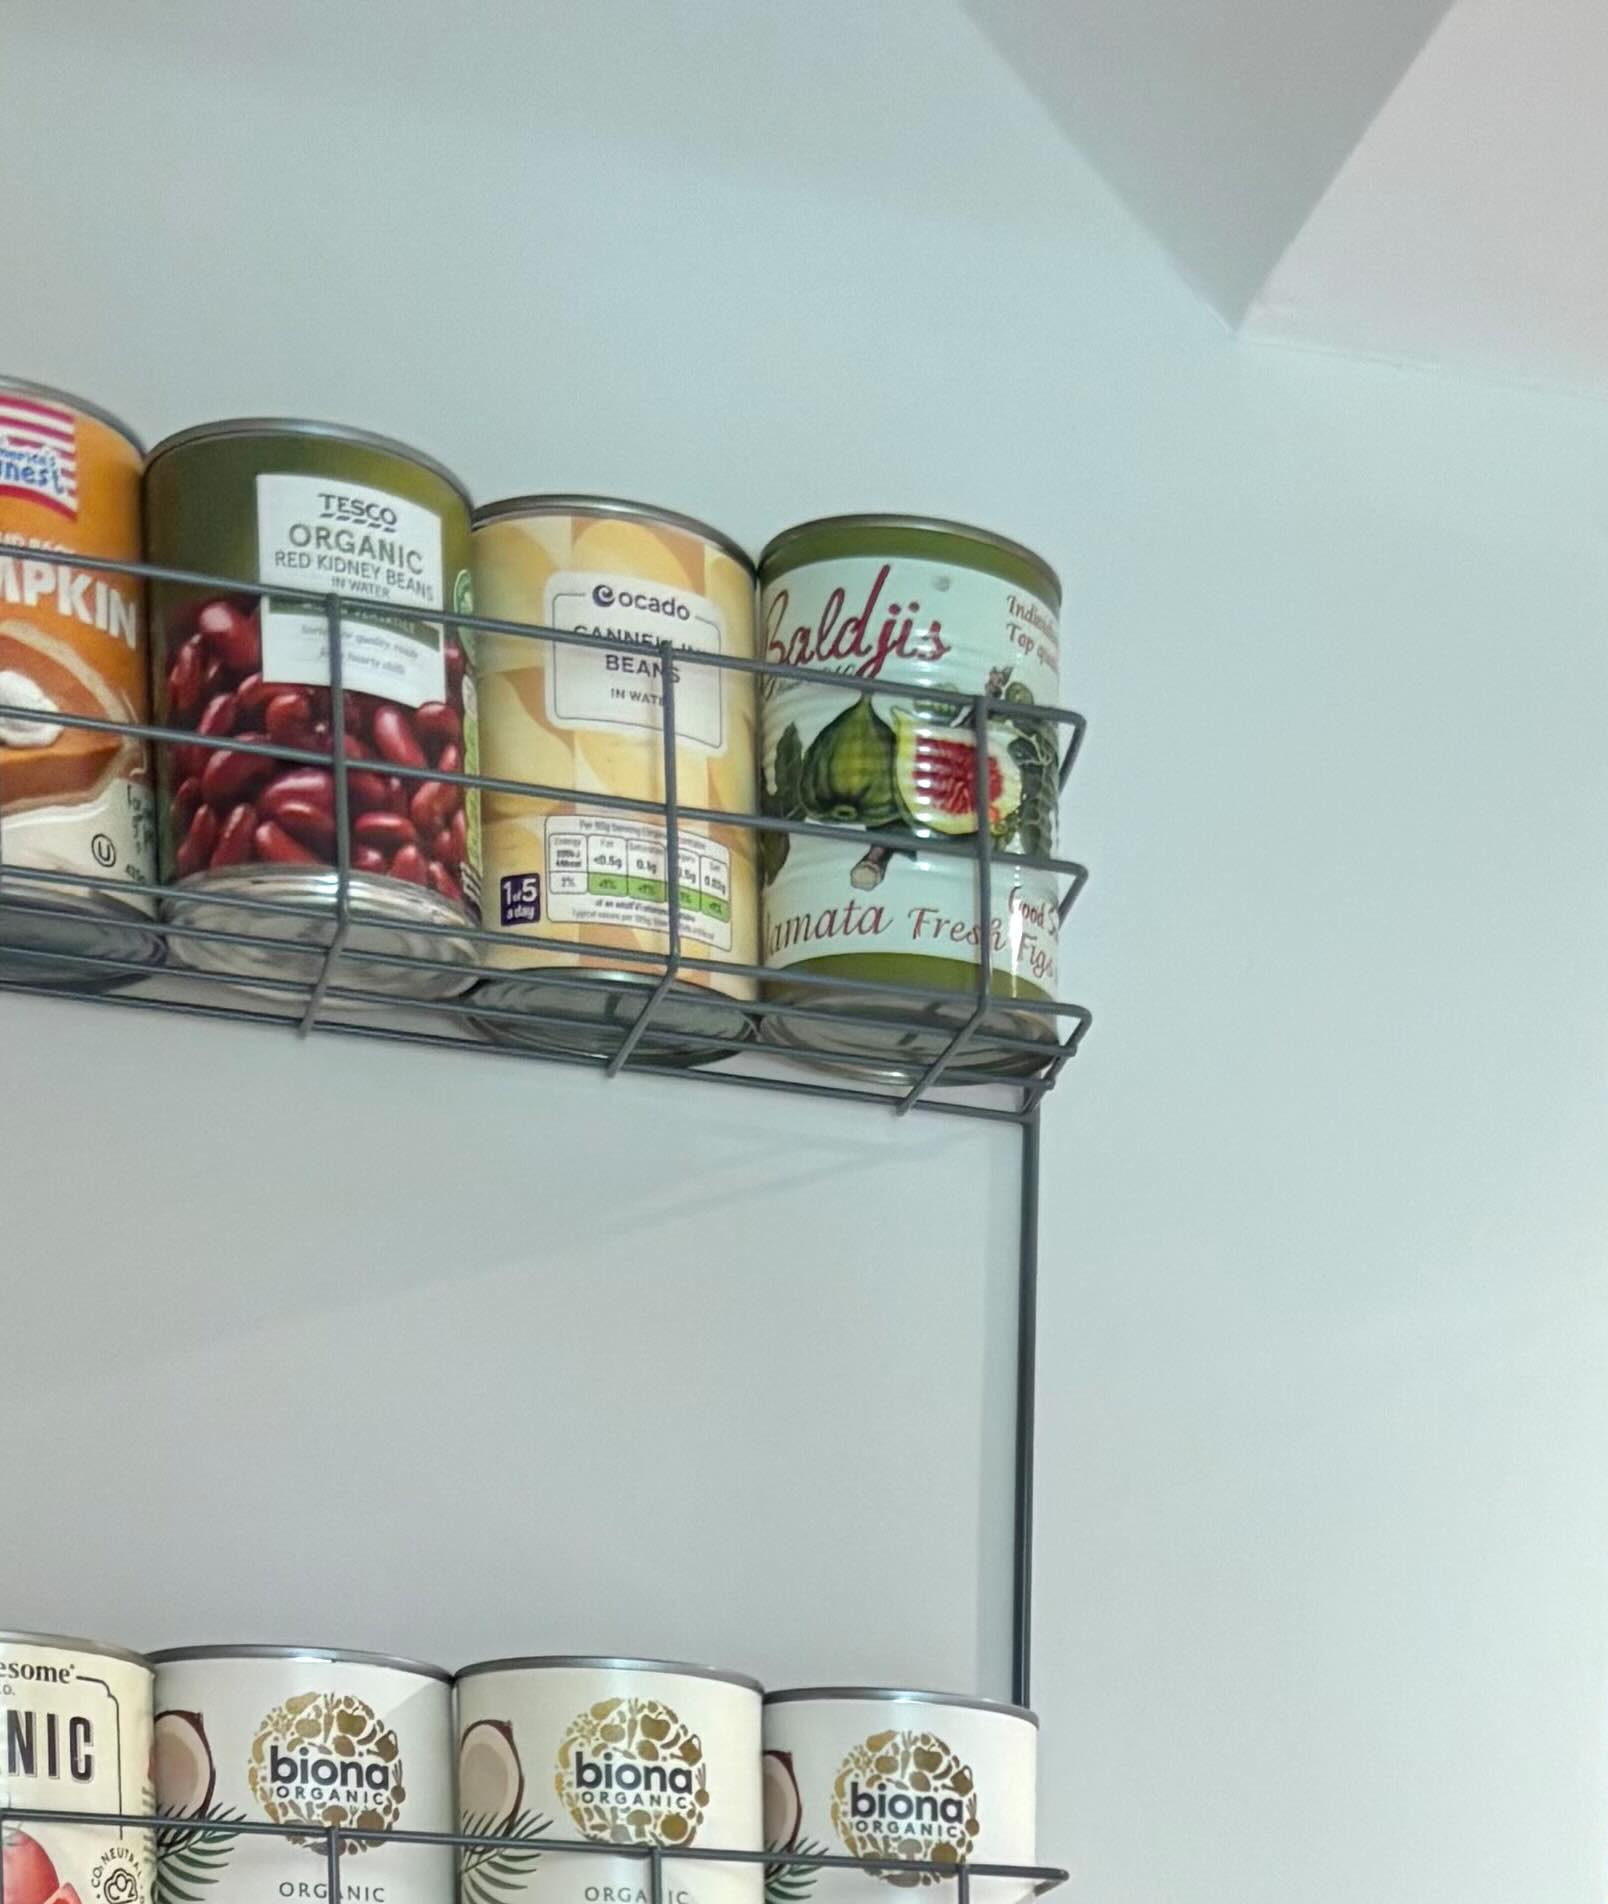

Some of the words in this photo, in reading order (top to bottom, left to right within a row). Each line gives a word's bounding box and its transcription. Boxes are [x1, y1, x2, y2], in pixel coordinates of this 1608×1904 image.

[318, 493, 398, 526] TESCO
[289, 523, 424, 576] ORGANIC
[275, 549, 312, 569] RED
[317, 553, 381, 581] KIDNEY
[386, 569, 434, 602] BEANS
[331, 576, 346, 589] IN
[350, 578, 392, 600] WATER
[618, 591, 691, 621] ocado
[1006, 622, 1034, 656] Top
[611, 688, 625, 700] IN
[630, 690, 664, 707] WAT
[503, 880, 512, 905] 1
[522, 878, 537, 902] 5
[907, 906, 1007, 952] Fresh
[270, 1745, 389, 1792] biona
[575, 1751, 693, 1795] biona
[276, 1786, 386, 1806] ORGANIC
[581, 1790, 690, 1810] ORGANIC
[851, 1782, 964, 1824] biona
[855, 1820, 959, 1839] ORGANIC
